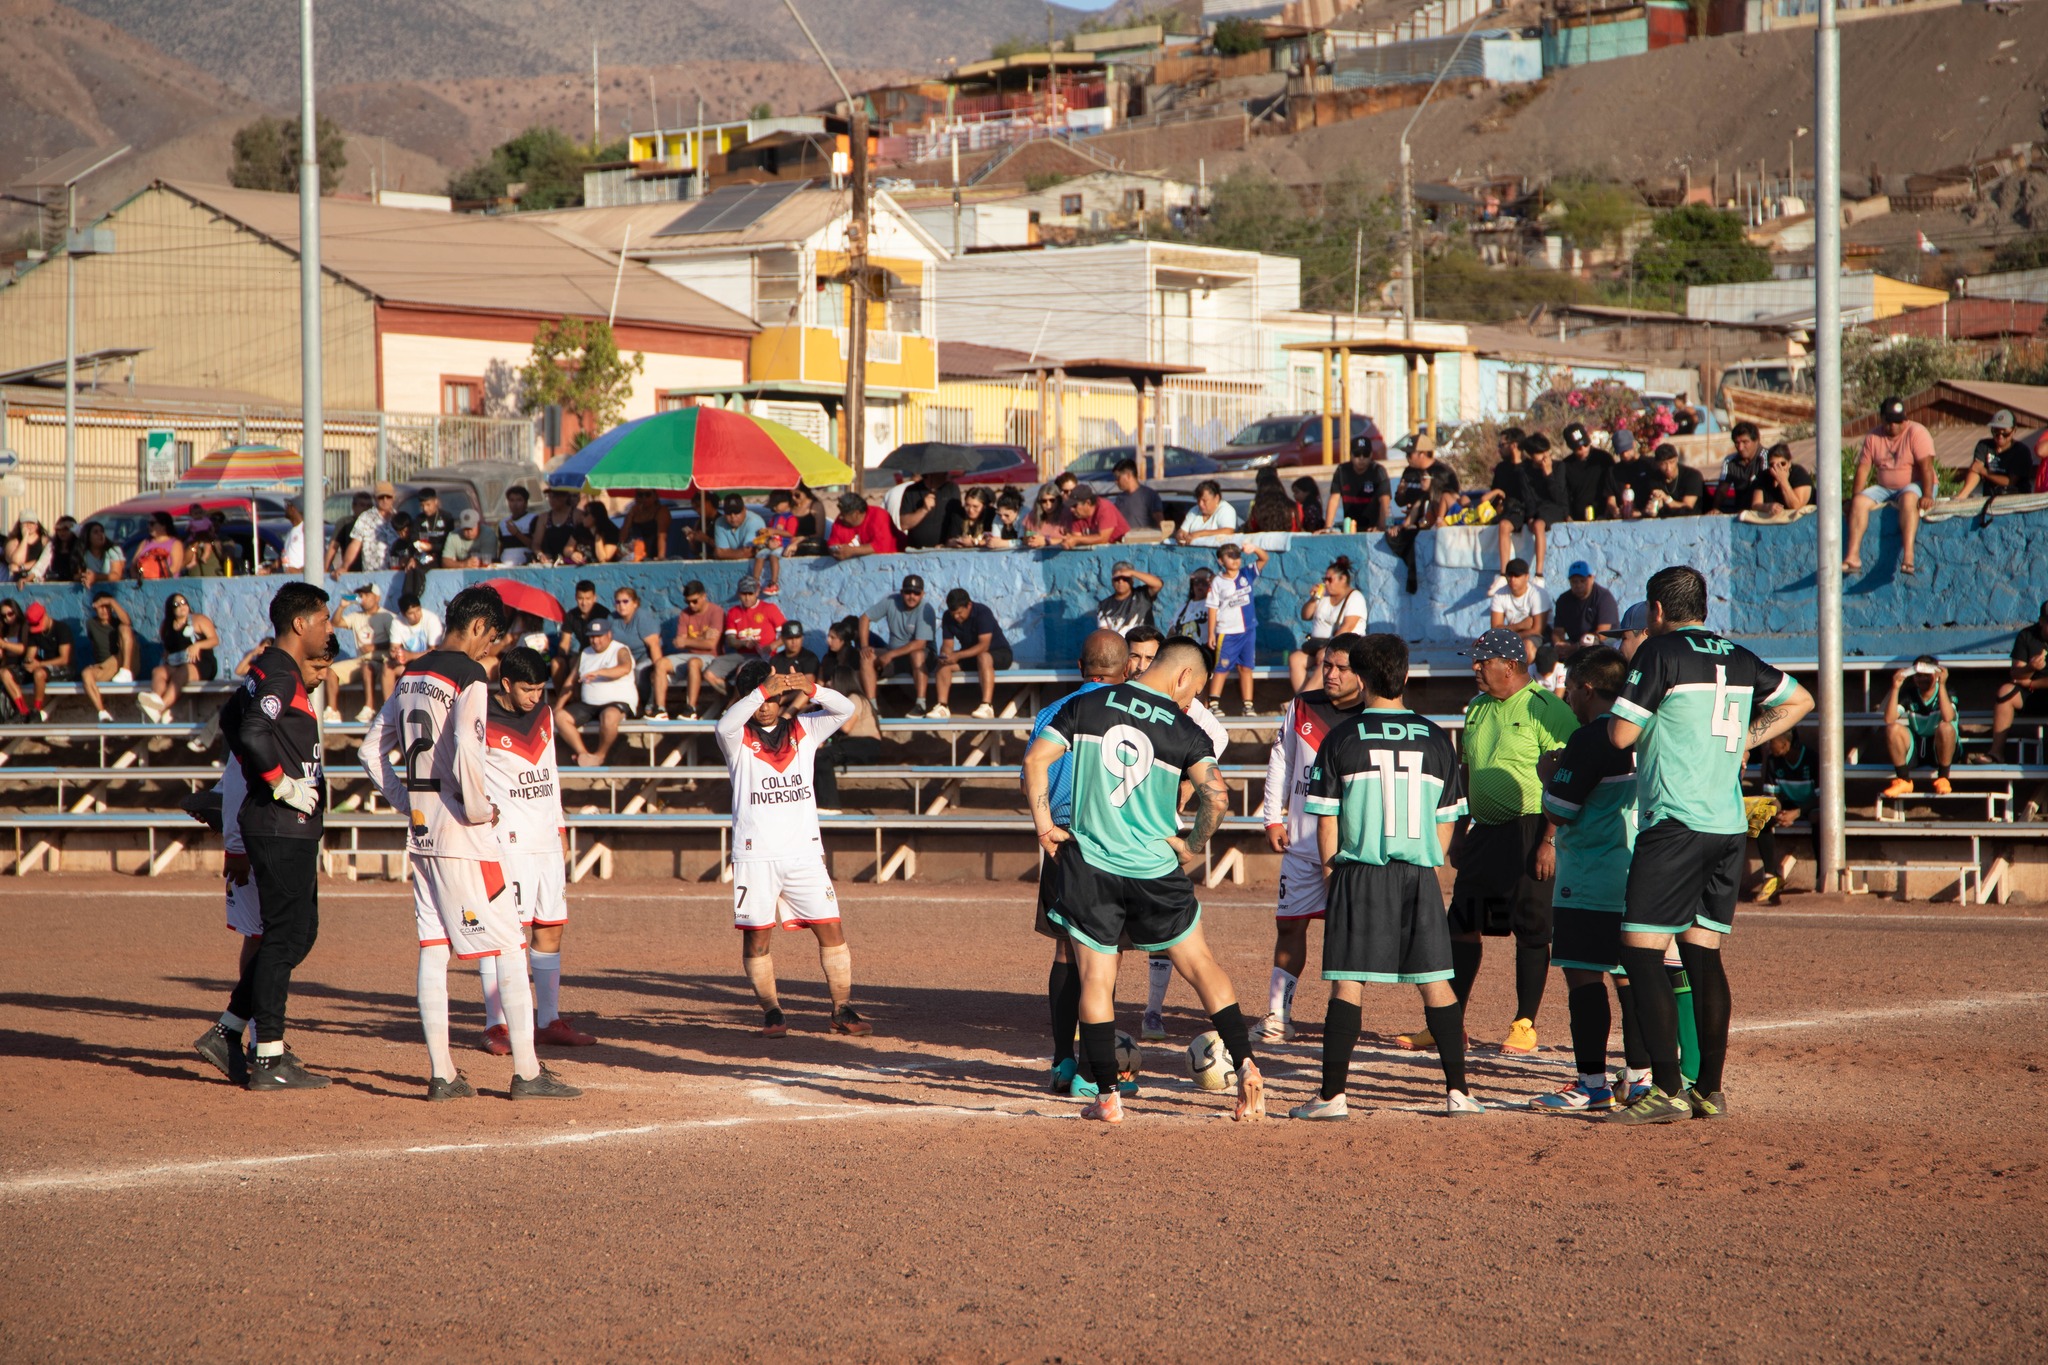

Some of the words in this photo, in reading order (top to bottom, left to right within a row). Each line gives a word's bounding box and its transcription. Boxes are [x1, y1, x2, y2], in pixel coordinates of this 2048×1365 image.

[1684, 635, 1736, 656] LDF
[1105, 691, 1176, 726] LDF
[1711, 664, 1742, 753] 4
[1357, 722, 1430, 741] LDF
[518, 768, 550, 785] COLLAO
[1100, 723, 1154, 809] 9
[761, 773, 803, 790] COLLAO
[1369, 749, 1424, 840] 11
[736, 885, 748, 909] 7
